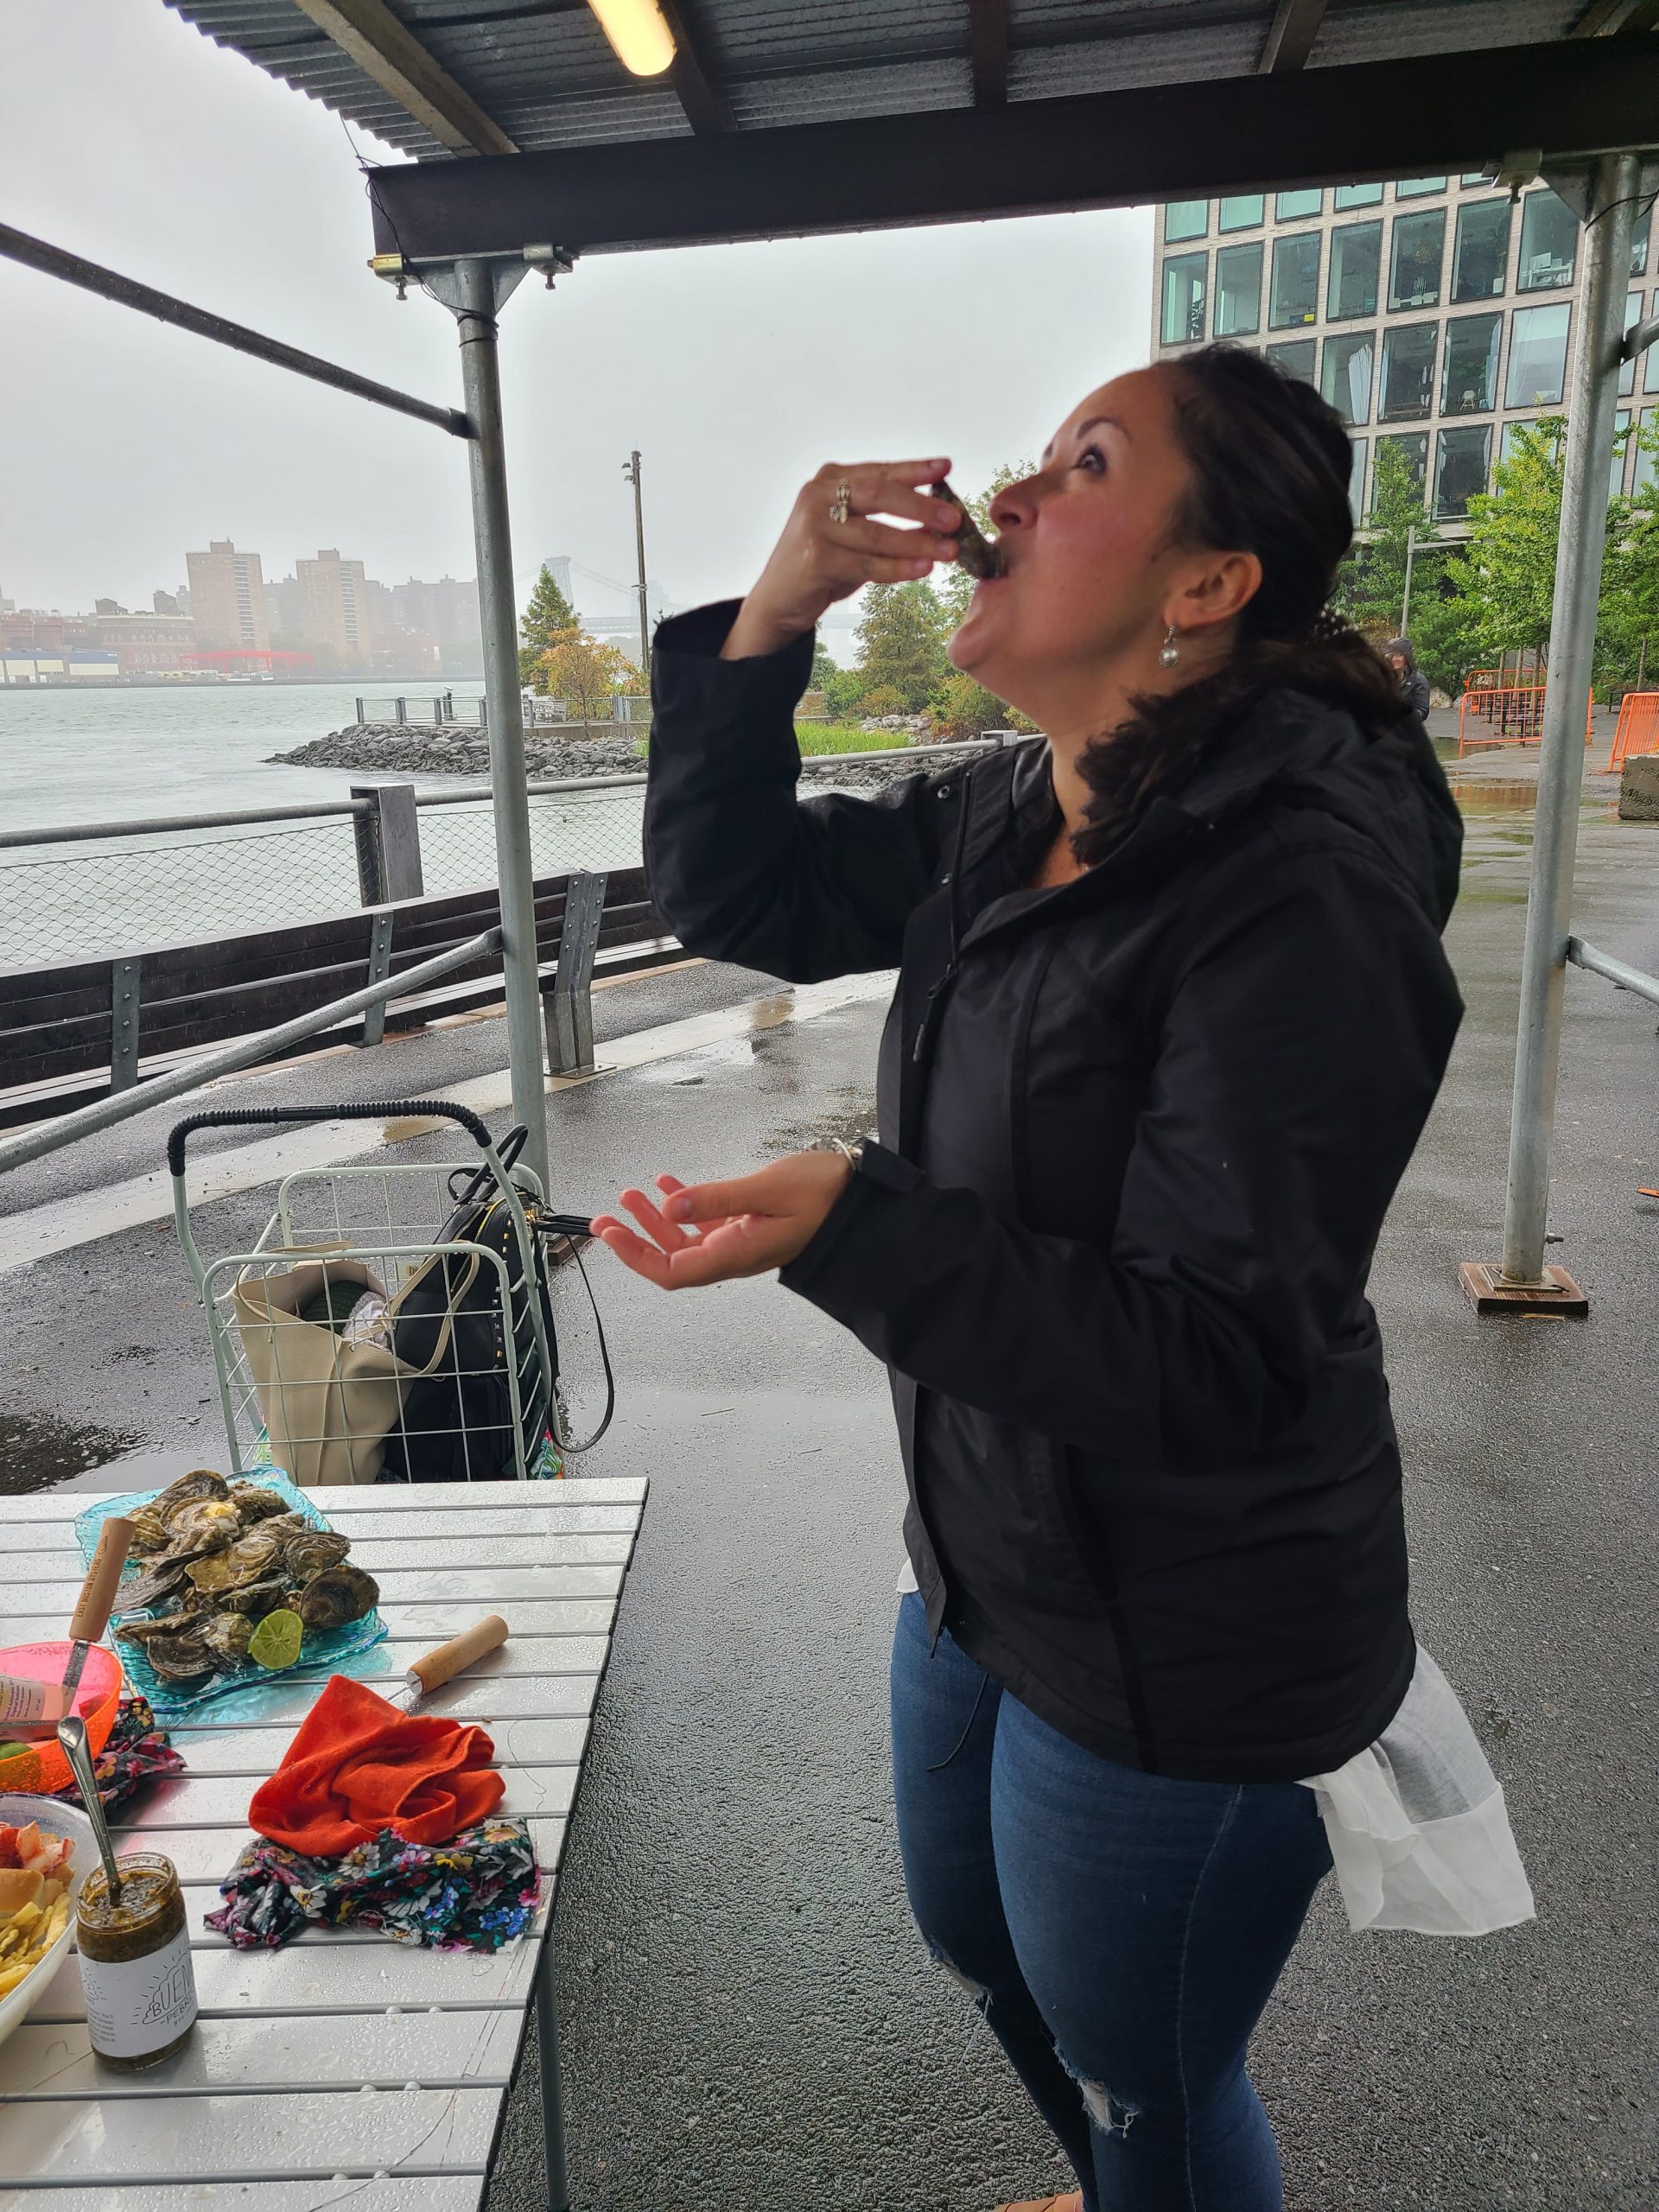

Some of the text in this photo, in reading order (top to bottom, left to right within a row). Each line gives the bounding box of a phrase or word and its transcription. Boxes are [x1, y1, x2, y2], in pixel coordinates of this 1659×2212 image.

[76, 1558, 101, 1618] EAST BOSTON OYSTERS
